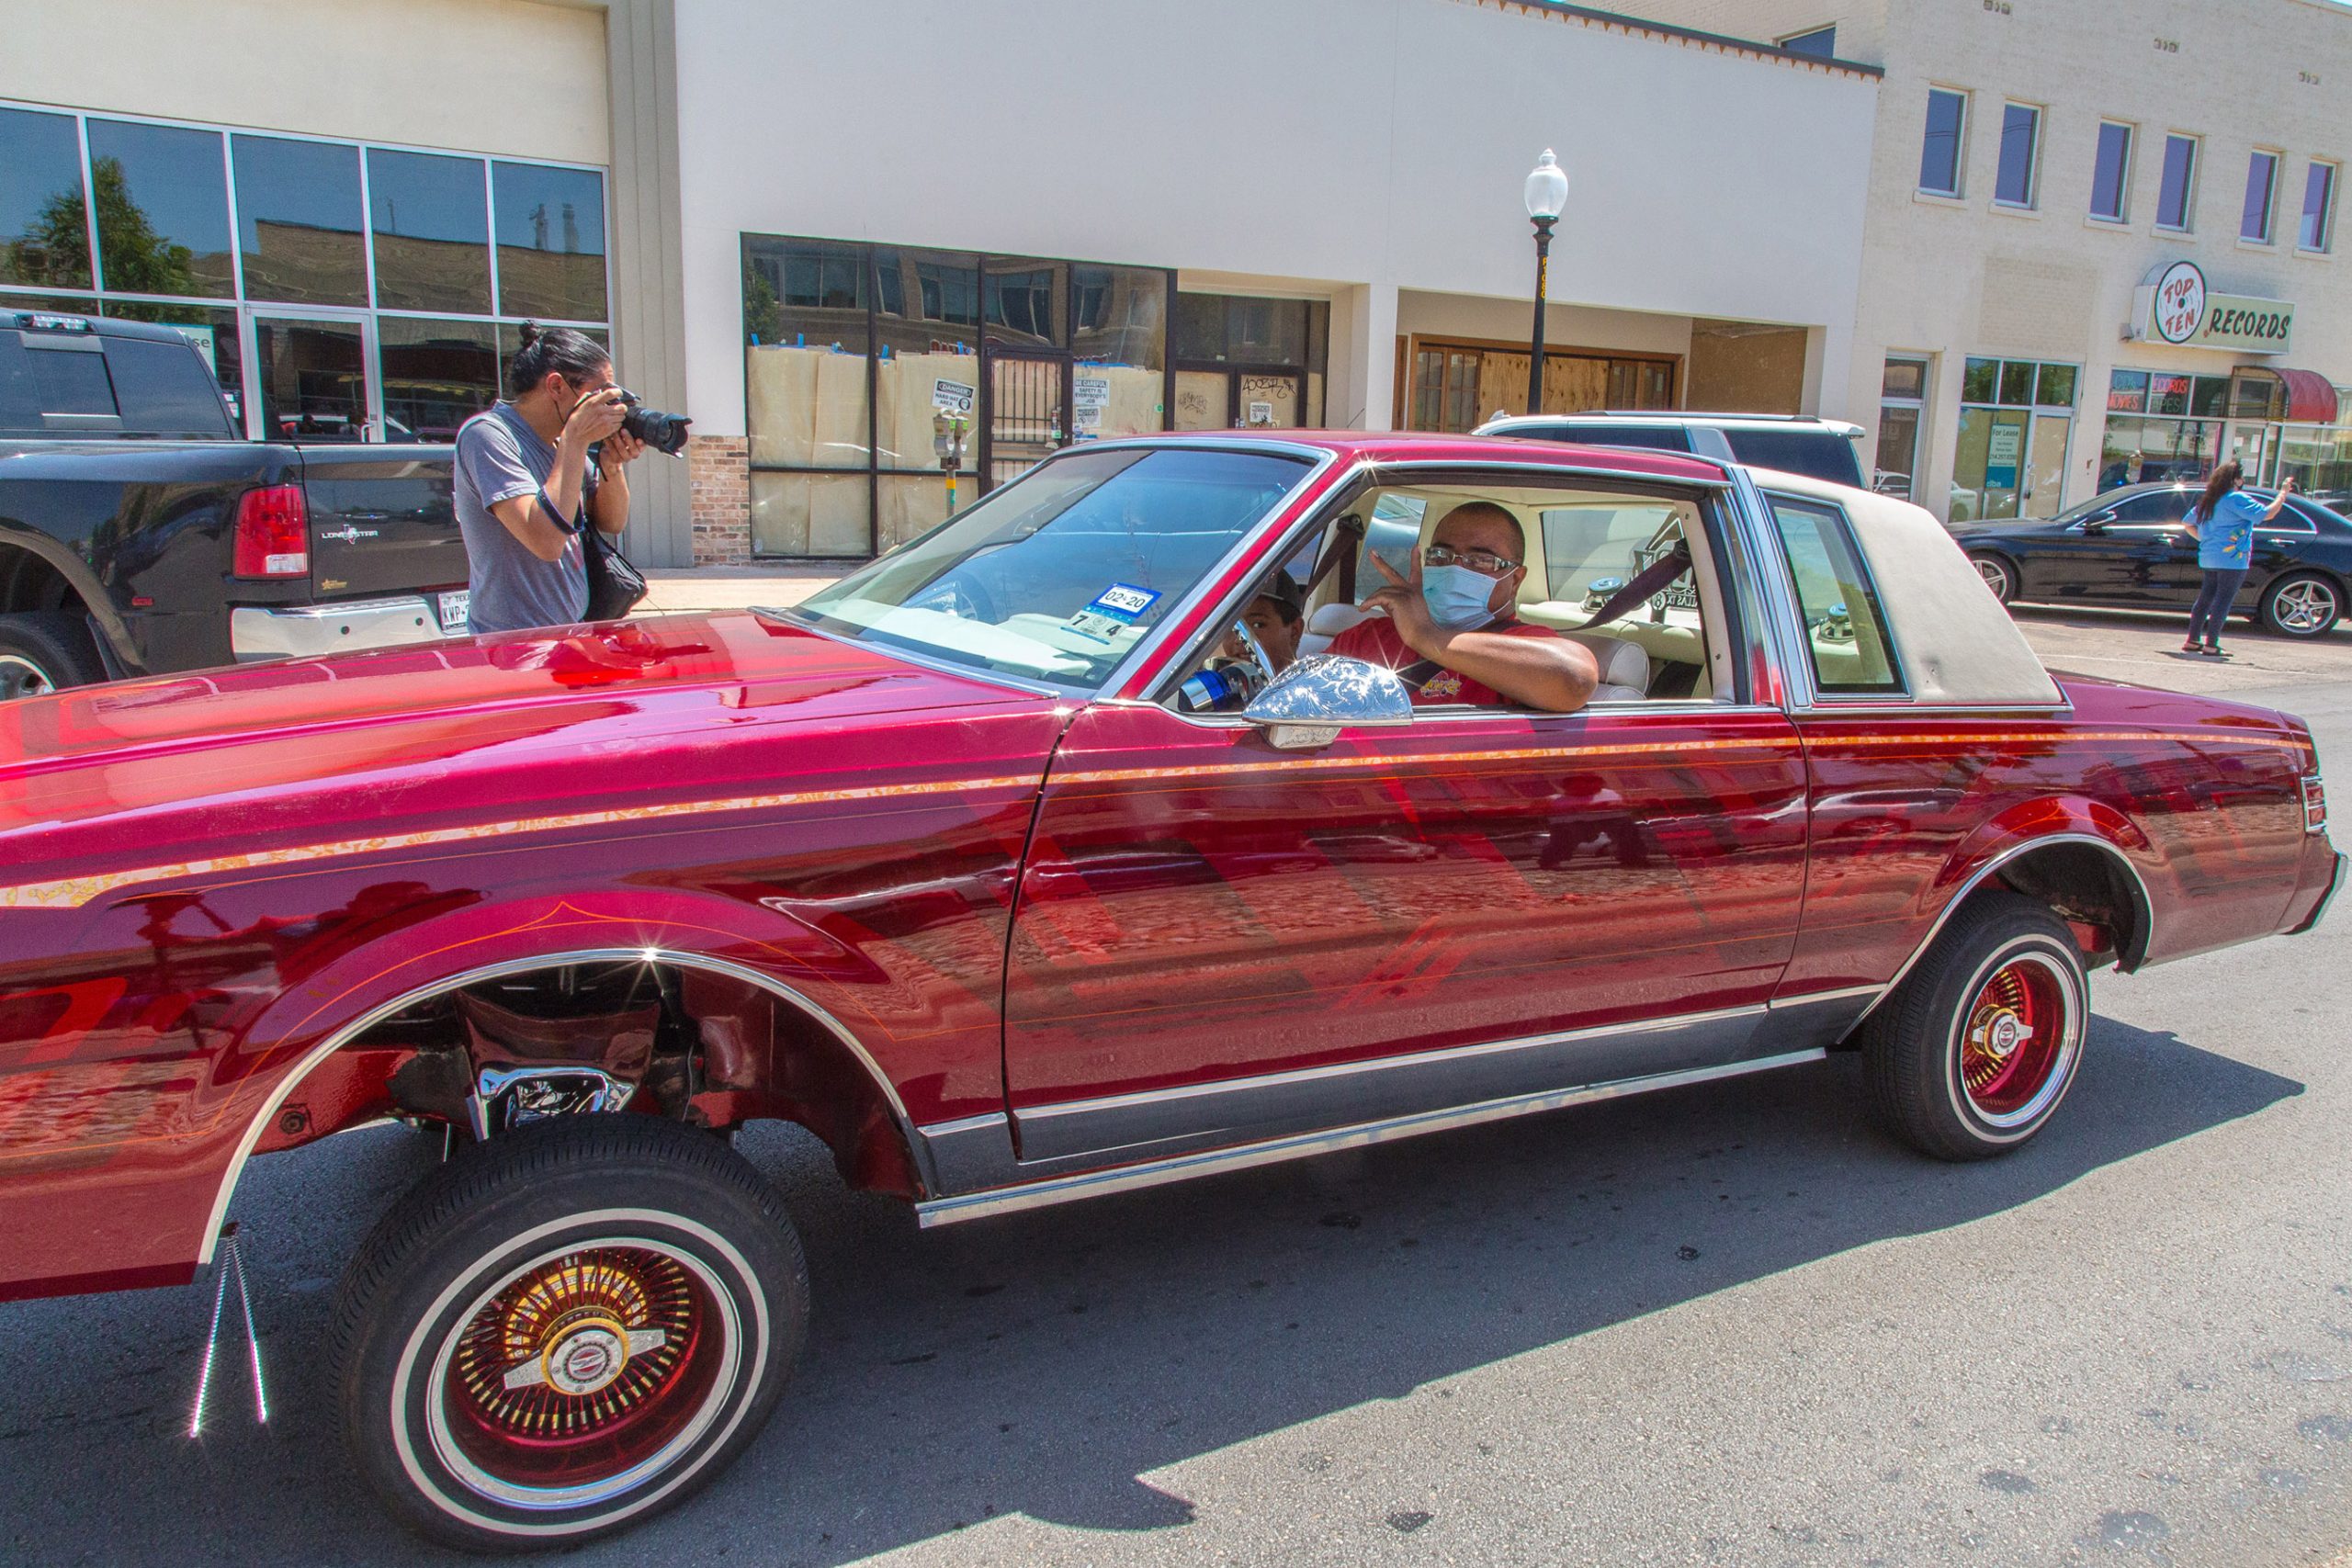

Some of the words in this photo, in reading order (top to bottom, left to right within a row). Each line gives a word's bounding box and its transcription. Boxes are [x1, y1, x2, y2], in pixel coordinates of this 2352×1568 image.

[2165, 277, 2194, 303] TOP
[2165, 309, 2195, 335] TEN
[2209, 308, 2290, 339] RECORDS
[193, 338, 210, 347] se
[943, 383, 967, 395] DANGER
[2152, 377, 2187, 394] ECORDS
[1106, 625, 1122, 637] 4
